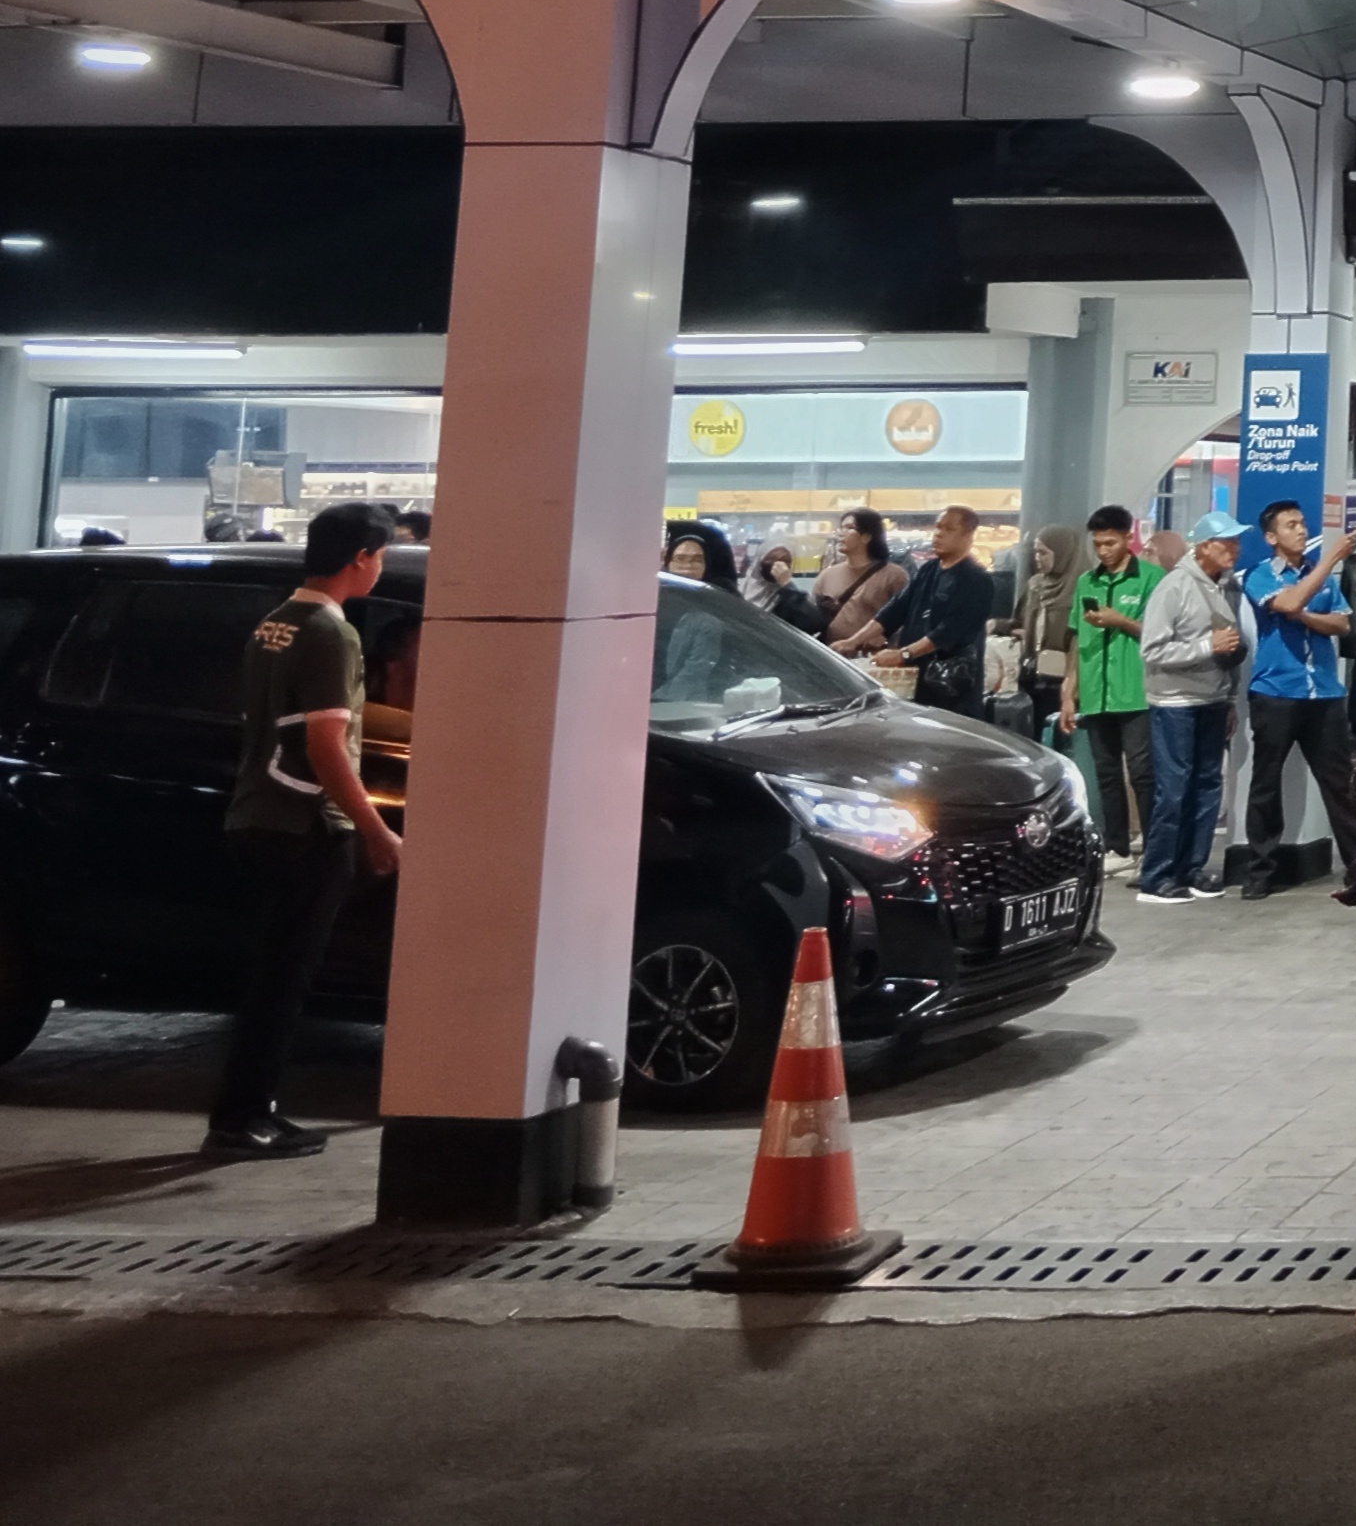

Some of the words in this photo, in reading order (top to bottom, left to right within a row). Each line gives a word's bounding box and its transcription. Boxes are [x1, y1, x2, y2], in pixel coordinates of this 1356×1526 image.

[693, 418, 739, 435] fresh!
[1248, 425, 1286, 439] Zona
[1288, 424, 1319, 437] Naik
[1247, 437, 1296, 450] /Turun
[1246, 449, 1290, 461] Drop-off
[1245, 460, 1290, 473] /Pick-up
[1291, 460, 1319, 472] Point
[1003, 905, 1014, 932] D
[1020, 896, 1048, 928] 1611
[1052, 886, 1077, 917] AJZ
